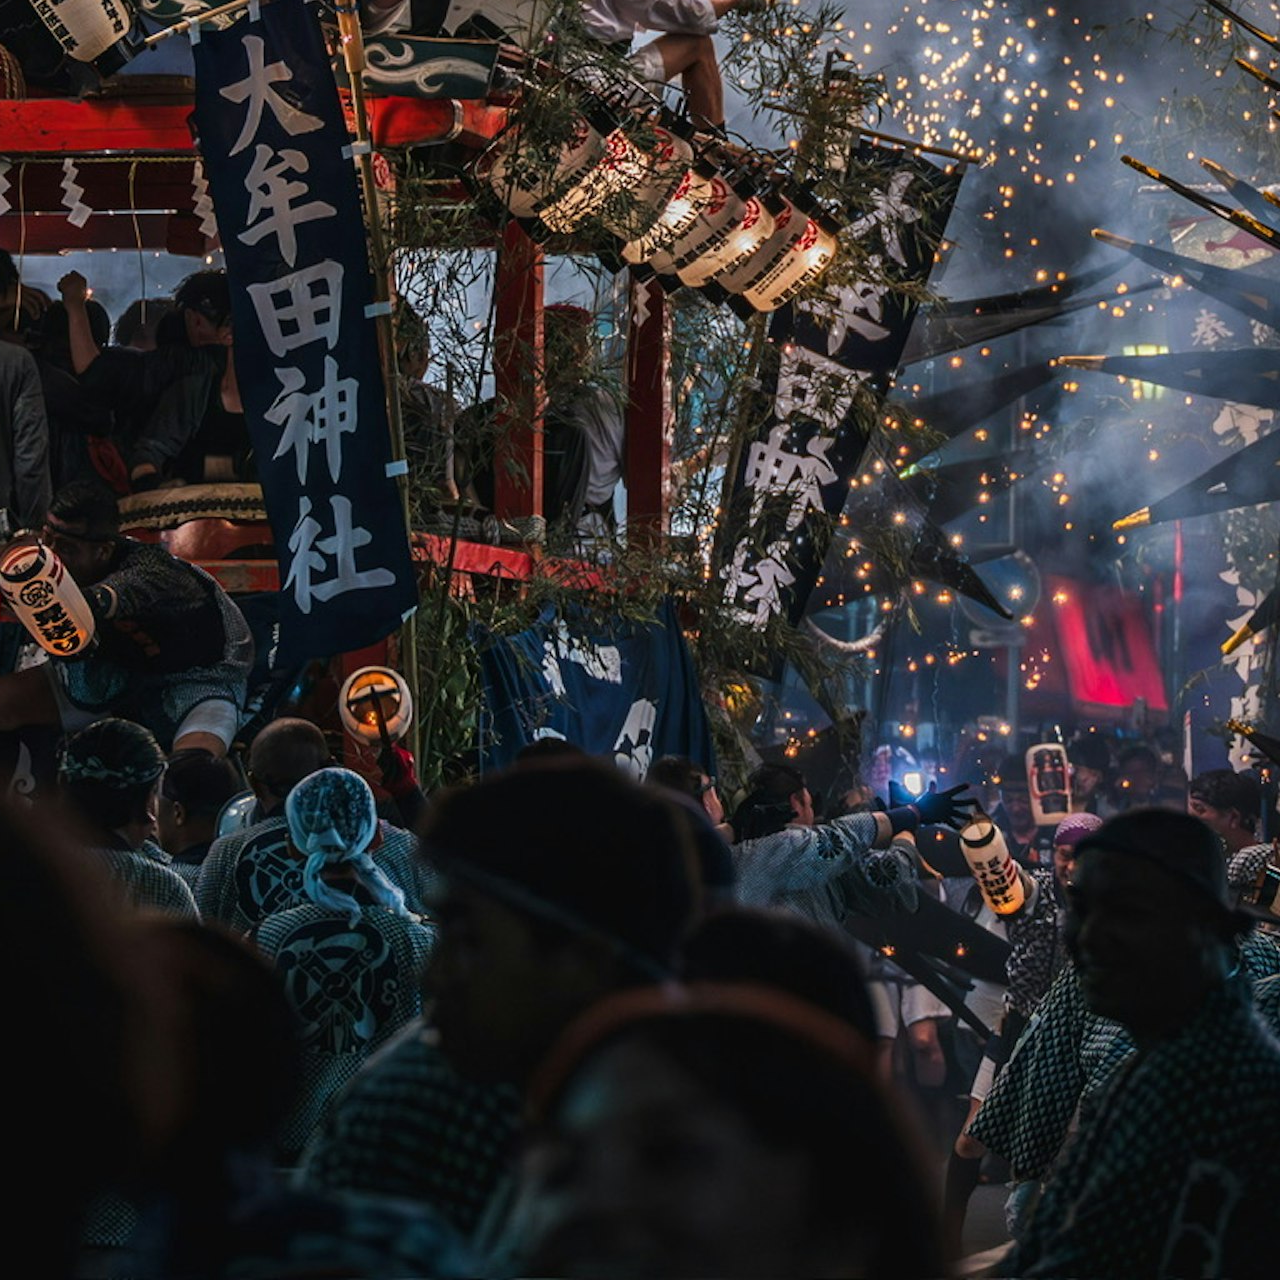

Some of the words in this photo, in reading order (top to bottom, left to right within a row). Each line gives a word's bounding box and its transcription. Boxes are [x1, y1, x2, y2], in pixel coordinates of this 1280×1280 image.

[217, 34, 398, 616] 大牟田神社
